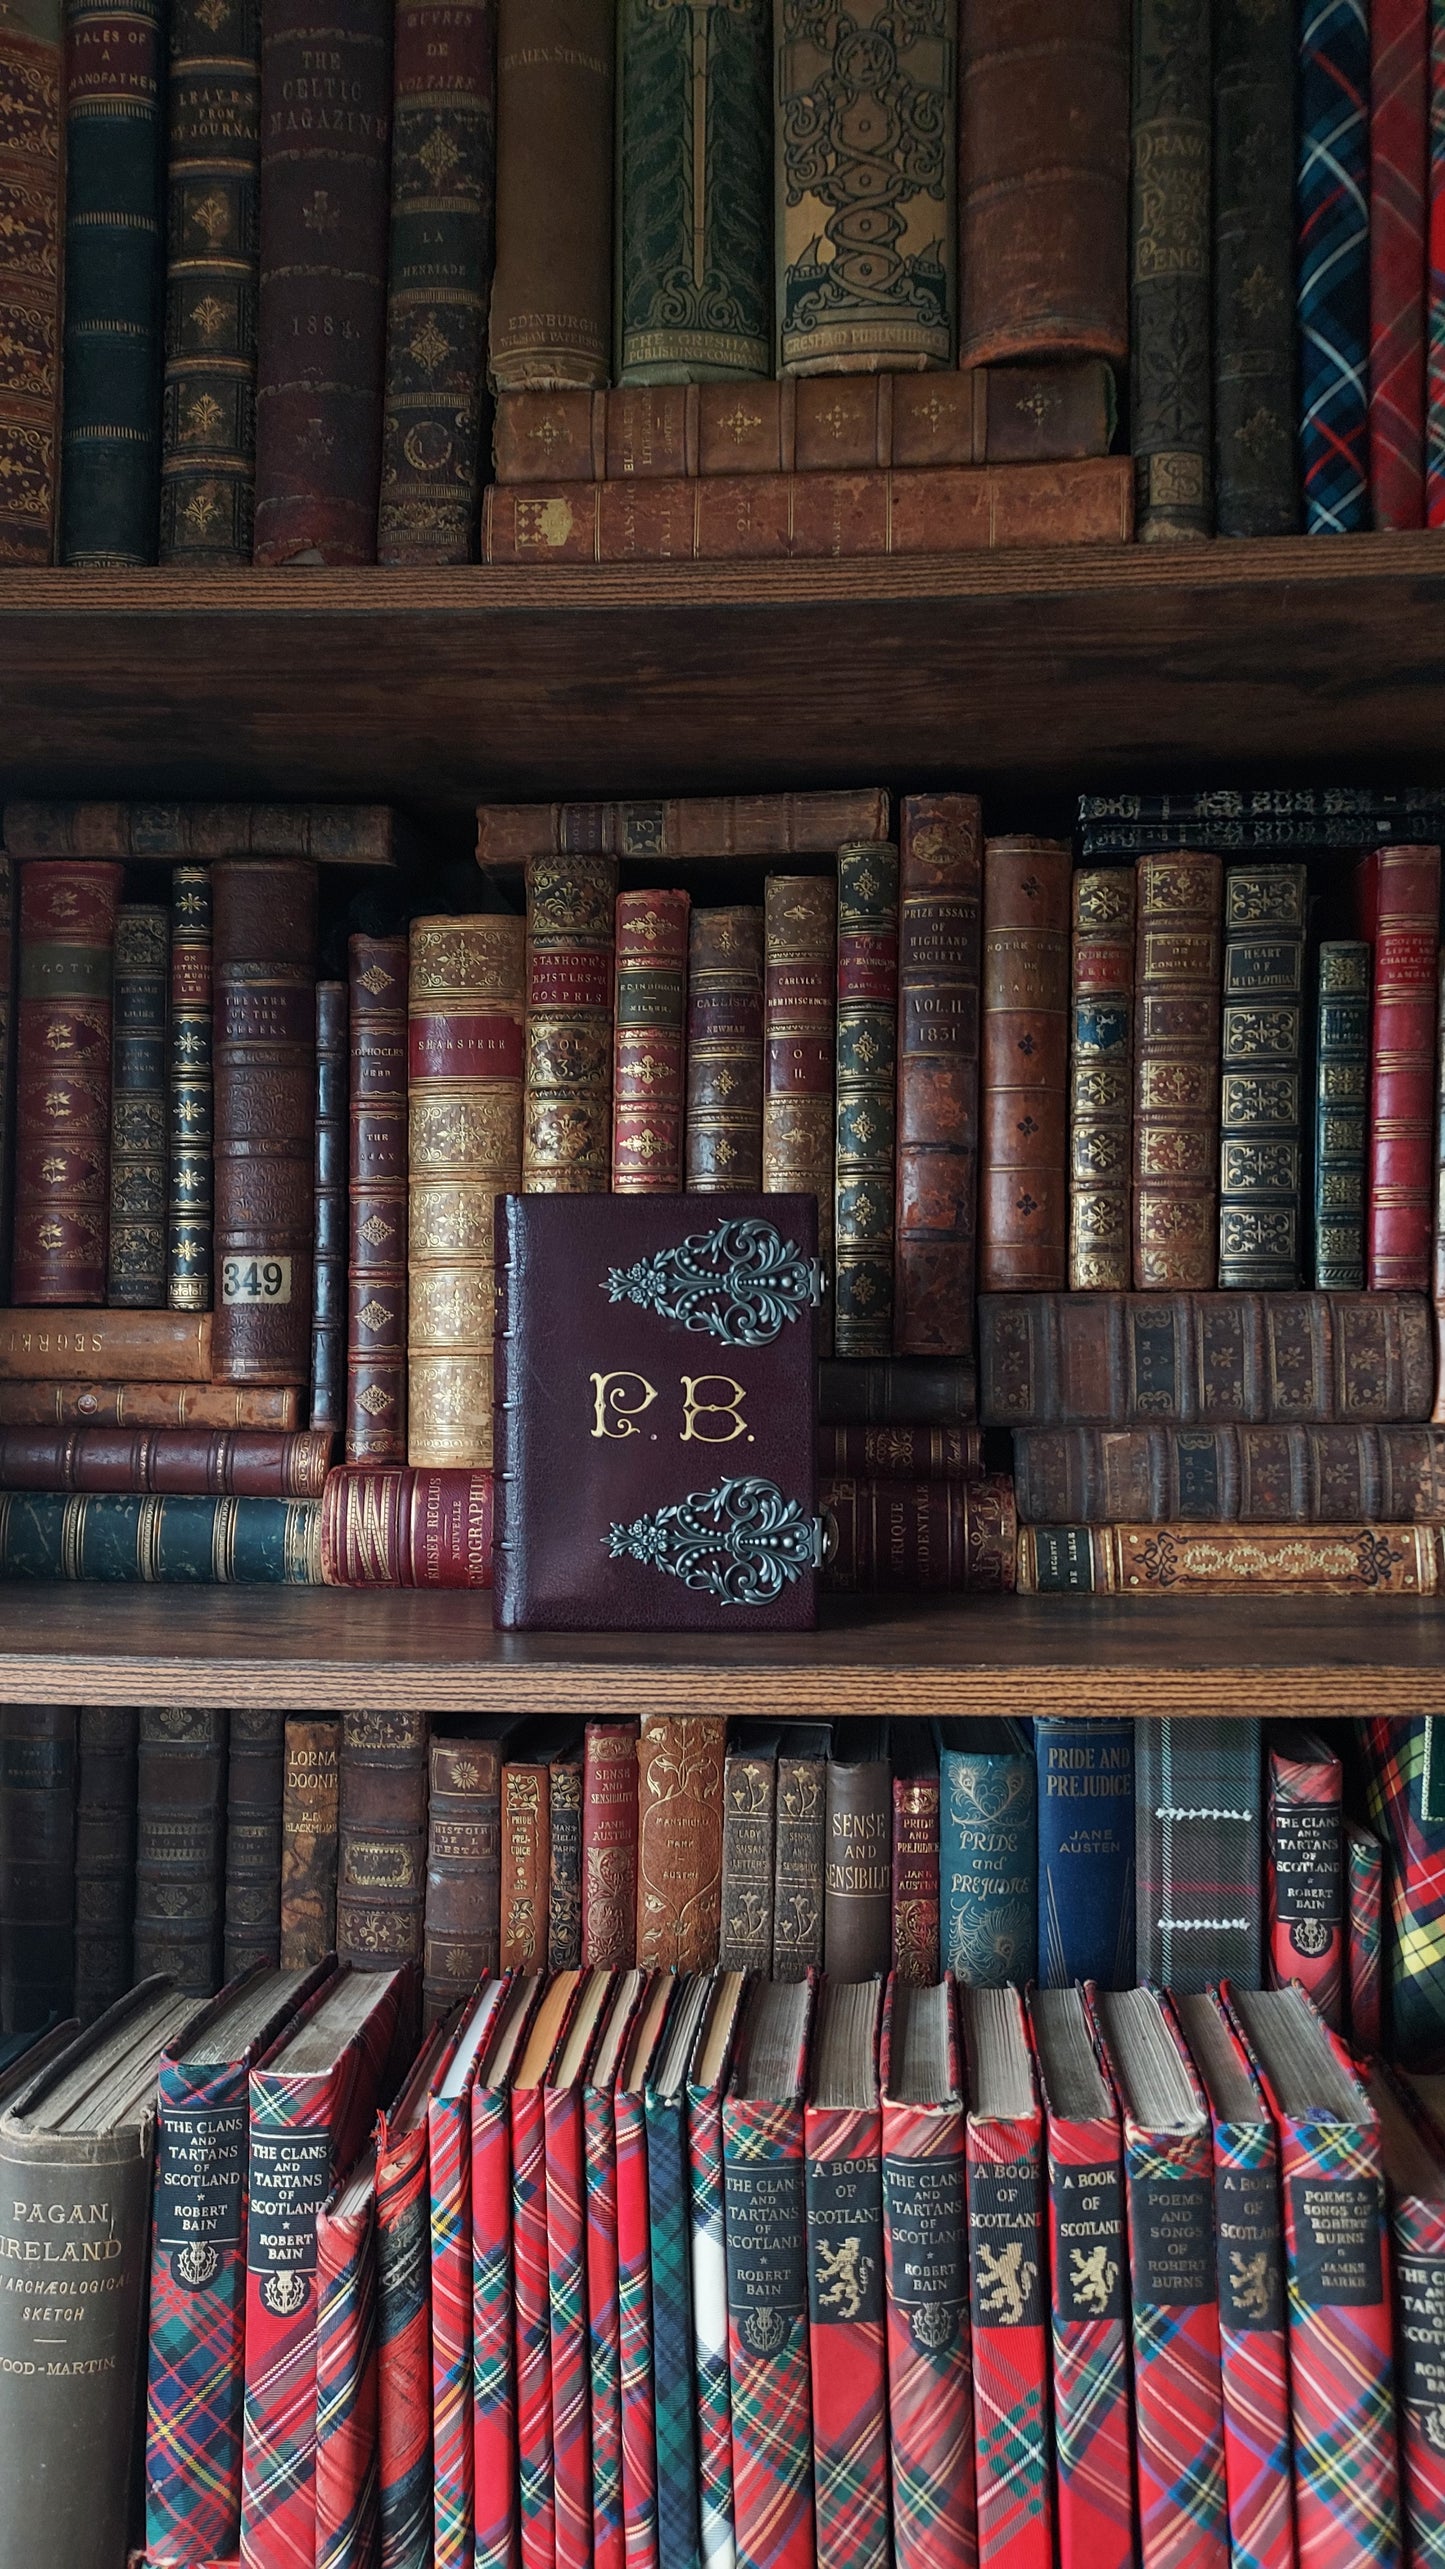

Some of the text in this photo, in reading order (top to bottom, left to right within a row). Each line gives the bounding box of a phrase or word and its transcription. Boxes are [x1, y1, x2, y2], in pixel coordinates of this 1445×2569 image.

[75, 30, 147, 46] TALES OF
[101, 49, 110, 61] A
[426, 42, 448, 57] DE
[301, 51, 341, 70] THE
[282, 77, 362, 102] CELTIC
[178, 88, 255, 106] LEAVES
[198, 108, 235, 121] FROM
[270, 107, 388, 141] MAGAZINE
[423, 230, 444, 245] LA
[402, 263, 466, 277] HENRIADE
[508, 313, 598, 332] EDINBURGH
[627, 332, 664, 349] THE
[904, 906, 977, 919] PRIZE ESSAYS
[931, 921, 946, 931] OF
[910, 935, 968, 947] HIGHLAND
[912, 951, 963, 961] SOCIETY
[1243, 948, 1282, 959] HEART
[532, 955, 607, 969] STANHOPE'S
[1253, 963, 1271, 972] OF
[532, 971, 591, 985] EPISTLES
[778, 974, 823, 987] CARLYLE'S
[1232, 973, 1297, 987] MID-LOTHIAN
[224, 996, 288, 1007] THEATRE
[532, 990, 603, 1003] GOSPELS
[697, 998, 760, 1011] CALLISTA
[914, 1000, 948, 1014] VOL.
[231, 1011, 278, 1021] OF THE
[226, 1025, 287, 1035] GREEKS
[707, 1025, 746, 1034] NEWMAN
[919, 1027, 957, 1042] 1831
[418, 1038, 506, 1051] SHAKSPERE
[545, 1038, 589, 1052] VOL.
[351, 1047, 404, 1057] SOPHOCLES
[557, 1058, 574, 1078] 3.
[794, 1068, 806, 1080] II.
[367, 1133, 389, 1141] THE
[224, 1262, 283, 1297] 349
[589, 1370, 756, 1443] P. B.
[422, 1478, 442, 1580] ÉLISÉE RECLUS
[451, 1500, 461, 1560] NOUVELLE
[464, 1474, 487, 1584] GÉOGRAPHIE
[1069, 1570, 1078, 1584] DE
[289, 1751, 337, 1766] LORNA
[1047, 1747, 1131, 1769] PRIDE AND
[595, 1769, 630, 1780] SENSE
[602, 1783, 622, 1791] AND
[1046, 1773, 1131, 1798] PREJUDICE
[591, 1792, 634, 1804] SENSIBILITY
[511, 1815, 531, 1824] PRIDE
[598, 1821, 624, 1829] JANE
[832, 1812, 886, 1838] SENSE
[903, 1818, 934, 1828] PRIDE
[1275, 1816, 1339, 1828] THE CLANS
[593, 1829, 631, 1841] AUSTEN
[738, 1830, 761, 1838] LADY
[789, 1833, 811, 1841] SENSE
[909, 1831, 928, 1840] AND
[1068, 1829, 1112, 1842] JANE
[667, 1840, 693, 1848] PARK
[898, 1842, 939, 1853] PREJUDICE
[959, 1829, 1018, 1853] PRIDE
[1278, 1839, 1338, 1851] TARTANS
[736, 1844, 764, 1853] SUSAN
[844, 1845, 876, 1858] AND
[1059, 1842, 1120, 1855] AUSTEN
[1302, 1852, 1316, 1860] OF
[732, 1859, 767, 1870] LETTERS
[782, 1862, 817, 1872] SENSIBILITY
[972, 1856, 1005, 1871] and
[1276, 1860, 1339, 1872] SCOTLAND
[662, 1872, 698, 1880] AUSTEN
[905, 1870, 932, 1878] JANE
[899, 1881, 937, 1890] AUSTEN
[952, 1873, 1030, 1900] PREJUDICE
[1287, 1888, 1332, 1899] ROBERT
[1295, 1899, 1325, 1910] BAIN
[165, 2118, 243, 2133] THE CLANS
[190, 2137, 216, 2146] AND
[169, 2146, 238, 2160] TARTANS
[252, 2146, 327, 2159] THE CLANS
[194, 2164, 209, 2172] OF
[274, 2163, 300, 2172] AND
[813, 2159, 878, 2177] A BOOK
[975, 2165, 1039, 2180] A BOOK
[164, 2173, 240, 2187] SCOTLAND
[254, 2174, 322, 2187] TARTANS
[726, 2178, 751, 2192] THE
[887, 2171, 964, 2187] THE CLANS
[1062, 2171, 1117, 2189] A BOOK
[1224, 2178, 1277, 2191] A BOOK
[279, 2190, 294, 2200] OF
[835, 2185, 856, 2198] OF
[914, 2190, 940, 2199] AND
[997, 2190, 1017, 2202] OF
[1305, 2191, 1367, 2202] POEMS &
[750, 2196, 776, 2205] AND
[1082, 2197, 1100, 2211] OF
[1150, 2195, 1202, 2206] POEMS
[12, 2202, 109, 2225] PAGAN
[174, 2205, 227, 2217] ROBERT
[251, 2201, 323, 2215] SCOTLAND
[729, 2207, 798, 2221] TARTANS
[893, 2202, 962, 2217] TARTANS
[1243, 2202, 1264, 2215] OF
[1304, 2204, 1370, 2216] SONGS OF
[1161, 2211, 1192, 2222] AND
[182, 2219, 217, 2231] BAIN
[756, 2225, 771, 2235] OF
[920, 2219, 936, 2229] OF
[1061, 2220, 1121, 2236] SCOTLAND
[1311, 2218, 1367, 2230] ROBERT
[892, 2229, 964, 2244] SCOTLAND
[1151, 2227, 1202, 2239] SONGS
[1315, 2232, 1364, 2244] BURNS
[260, 2234, 313, 2246] ROBERT
[0, 2239, 122, 2262] IRELAND
[268, 2248, 303, 2260] BAIN
[1168, 2244, 1188, 2255] OF
[905, 2264, 956, 2277] ROBERT
[1148, 2259, 1207, 2272] ROBERT
[1320, 2262, 1365, 2274] JAMES
[736, 2269, 791, 2282] ROBERT
[1152, 2276, 1203, 2288] BURNS
[1322, 2275, 1366, 2287] BARKE
[1399, 2267, 1428, 2285] THE
[746, 2284, 782, 2296] BAIN
[914, 2280, 947, 2291] BAIN
[22, 2307, 85, 2322] SKETCH
